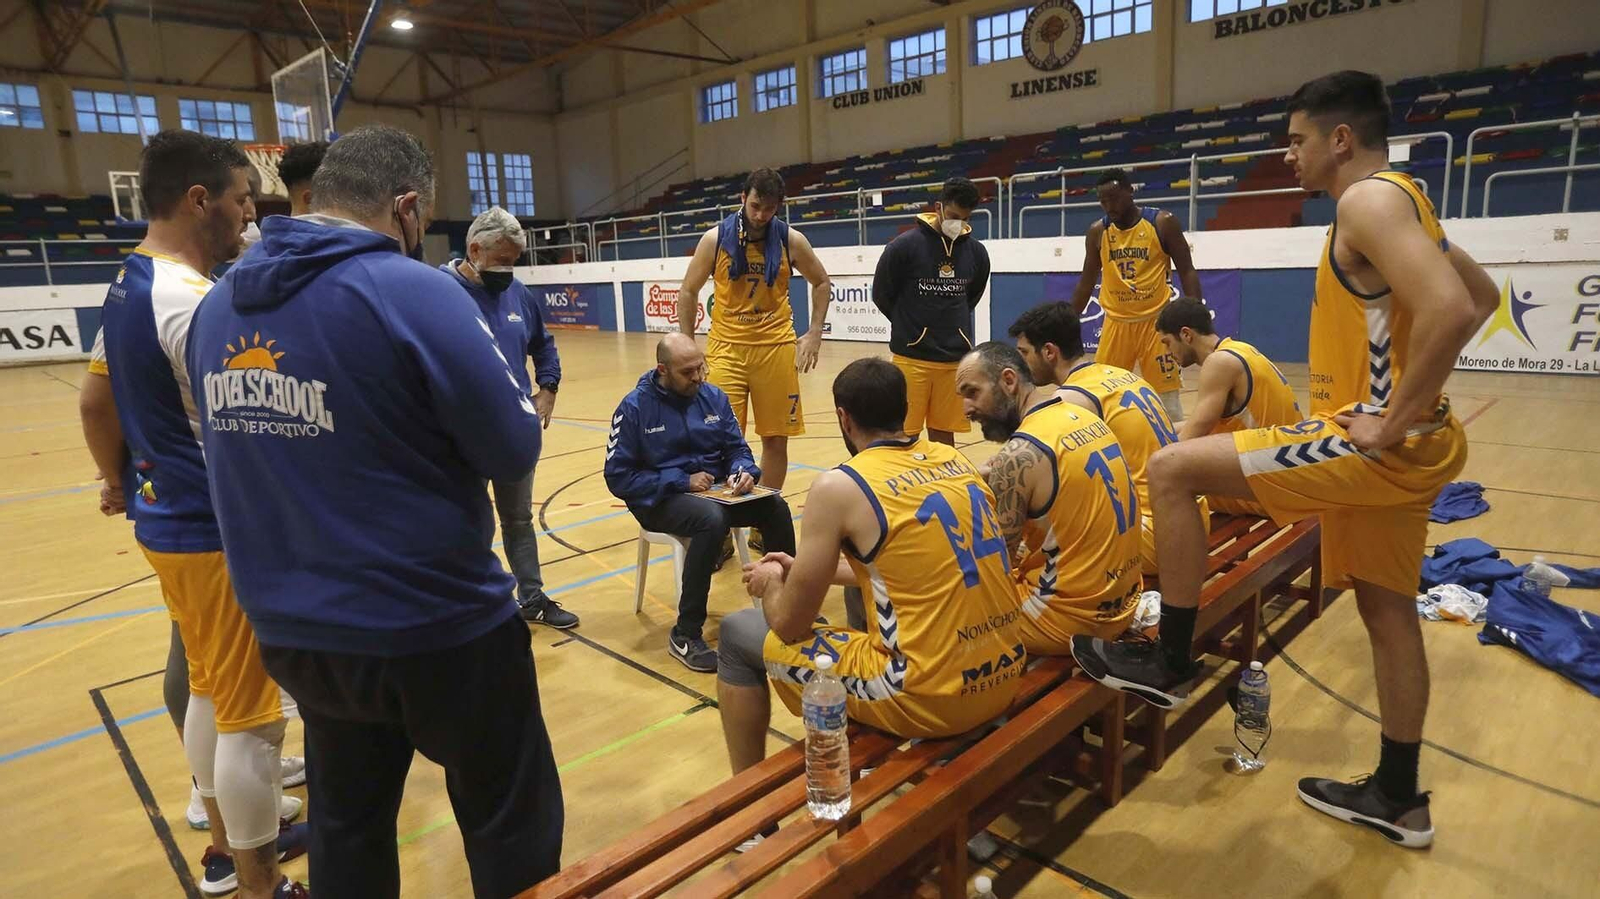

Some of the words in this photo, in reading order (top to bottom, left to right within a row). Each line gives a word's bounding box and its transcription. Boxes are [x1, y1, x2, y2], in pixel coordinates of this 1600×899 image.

[1214, 0, 1402, 38] BALONCES
[1010, 69, 1097, 98] LINENSE
[833, 91, 869, 109] CLUB
[873, 80, 923, 102] UNION
[1117, 261, 1136, 280] 15
[747, 278, 759, 298] 7
[829, 282, 872, 302] Sumi
[545, 292, 568, 307] MGS
[1572, 303, 1600, 324] F
[1156, 352, 1176, 373] 15
[1459, 356, 1498, 368] Moreno
[1502, 358, 1515, 368] de
[1518, 358, 1546, 369] Mora
[1550, 359, 1564, 370] 29
[1575, 360, 1589, 371] La
[788, 394, 799, 414] 7
[212, 417, 238, 431] CLUB
[240, 418, 320, 438] DEPORTIVO
[1120, 387, 1178, 448] 10
[1084, 443, 1137, 535] 17
[915, 483, 1010, 589] 14
[957, 609, 1019, 643] NOVASCHO
[961, 662, 1024, 696] PREVENCI
